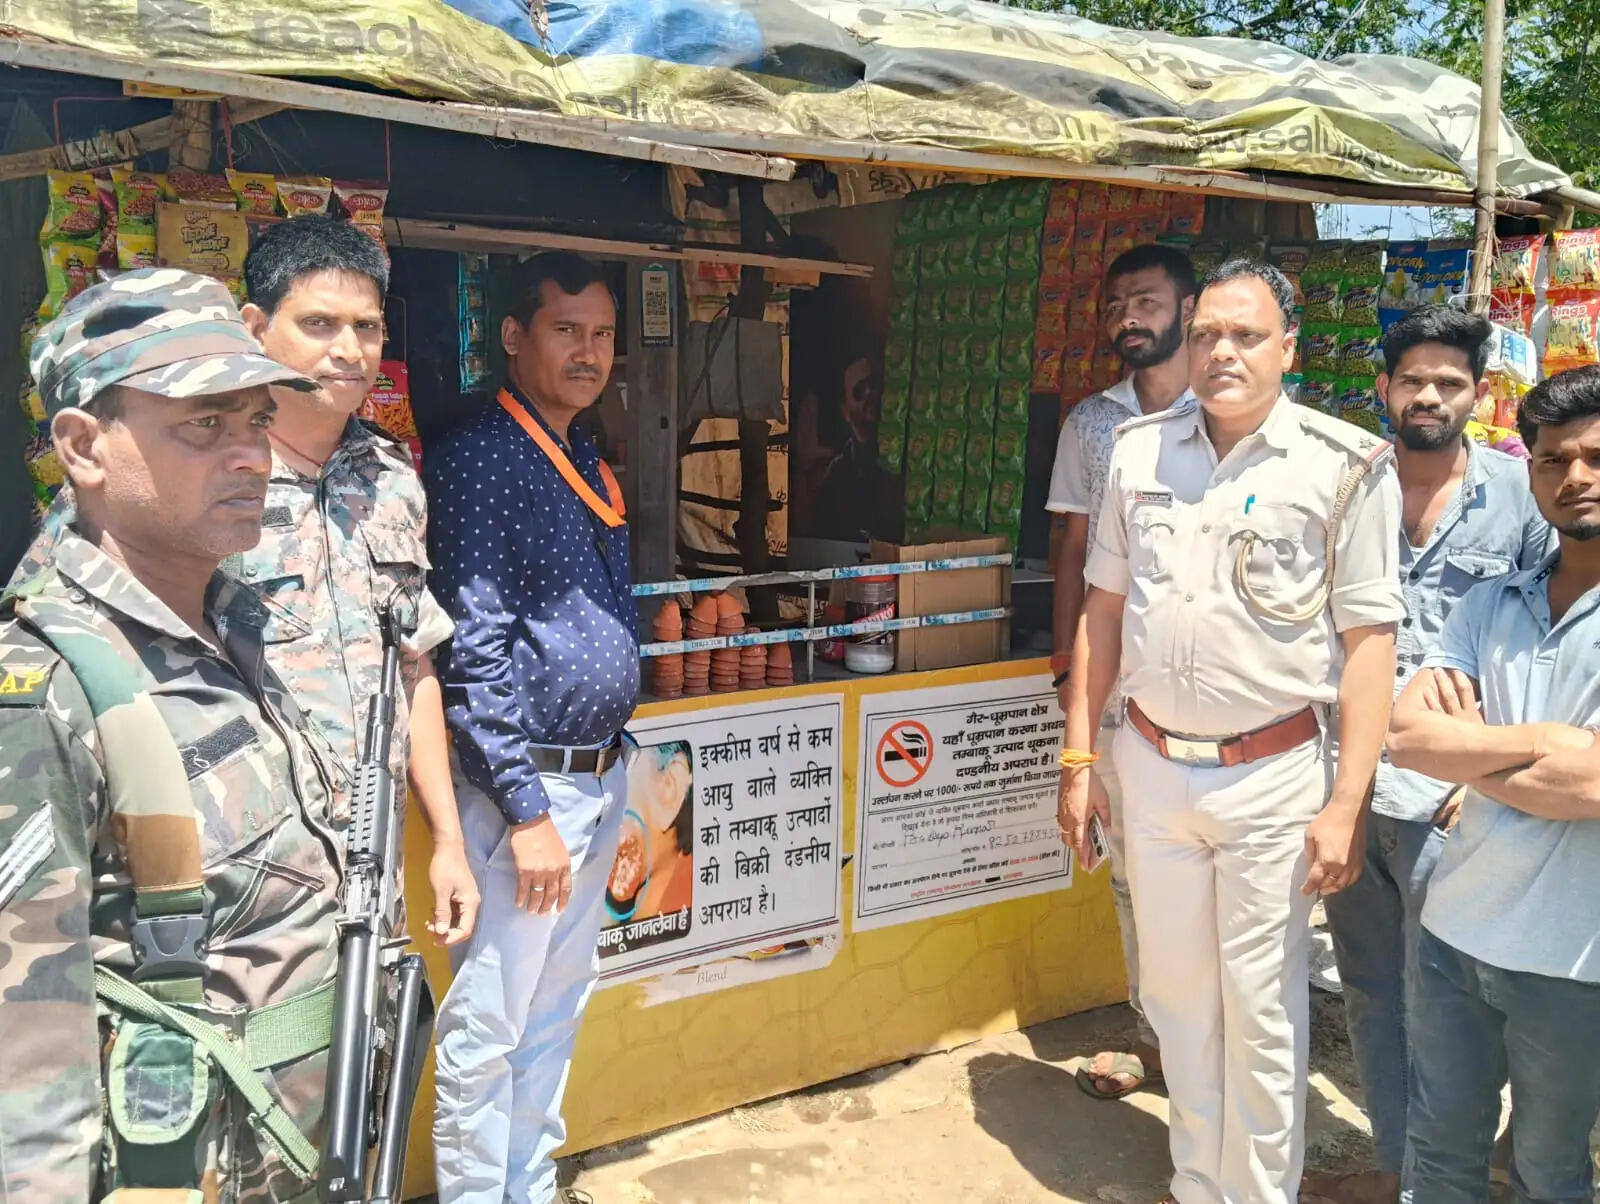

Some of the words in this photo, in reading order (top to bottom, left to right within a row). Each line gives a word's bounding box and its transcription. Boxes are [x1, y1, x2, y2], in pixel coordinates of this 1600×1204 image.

[1550, 305, 1588, 319] Rings
[1031, 704, 1048, 717] क्षेत्र
[1008, 724, 1037, 736] करना
[1040, 720, 1065, 732] अथव
[699, 732, 752, 771] इक्कीस
[758, 725, 782, 756] वर्ष
[787, 724, 801, 752] से
[807, 727, 833, 749] कम
[952, 746, 992, 760] तम्बाकू
[993, 741, 1024, 754] उत्पाद
[956, 761, 999, 778] दण्डनीय
[1002, 757, 1038, 771] अपराध
[701, 783, 733, 811] आयु
[747, 767, 776, 798] वाले
[790, 761, 832, 790] व्यक्ति
[700, 817, 720, 847] को
[729, 814, 778, 840] तम्बाकू
[786, 797, 831, 832] उत्पादों
[700, 856, 720, 886] की
[735, 846, 770, 879] बिक्री
[784, 837, 831, 868] दंडनीय
[625, 910, 678, 940] जानलेवा
[678, 903, 688, 931] है
[699, 897, 752, 925] अपराध
[696, 966, 728, 985] Blend
